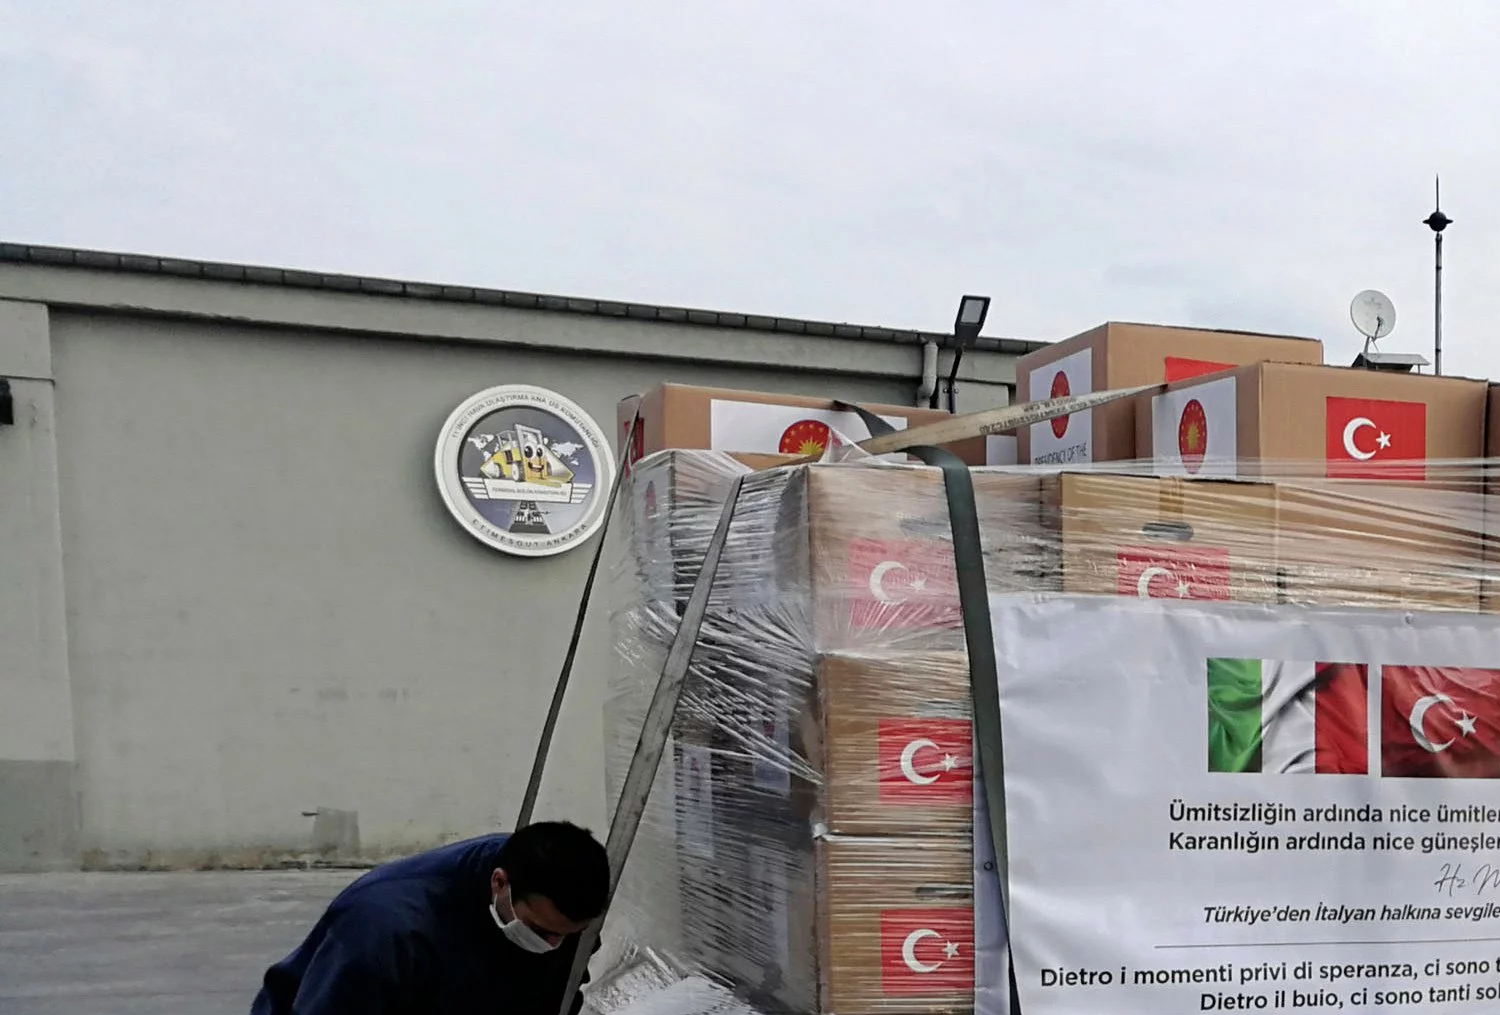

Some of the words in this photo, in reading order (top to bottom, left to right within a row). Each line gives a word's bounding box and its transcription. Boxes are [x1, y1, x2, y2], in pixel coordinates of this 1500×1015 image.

[1169, 799, 1296, 825] Ümitsizliğin
[1303, 804, 1383, 823] ardında
[1390, 804, 1431, 823] nice
[1169, 831, 1279, 853] Karanlığın
[1286, 832, 1365, 850] ardında
[1373, 832, 1415, 850] nice
[1204, 905, 1310, 925] Türkiye'den
[1315, 901, 1375, 924] İtalyan
[1380, 903, 1441, 921] halkına
[1041, 967, 1113, 986] Dietro
[1120, 966, 1126, 985] i
[1134, 964, 1233, 985] momenti
[1240, 963, 1287, 984] privi
[1293, 961, 1312, 980] di
[1319, 962, 1418, 984] speranza,
[1424, 958, 1440, 977] ci
[1446, 960, 1490, 976] sono
[1200, 992, 1268, 1011] Dietro
[1275, 990, 1285, 1008] il
[1292, 989, 1344, 1010] buio,
[1350, 988, 1367, 1006] ci
[1374, 989, 1423, 1006] sono
[1429, 985, 1470, 1003] tanti
